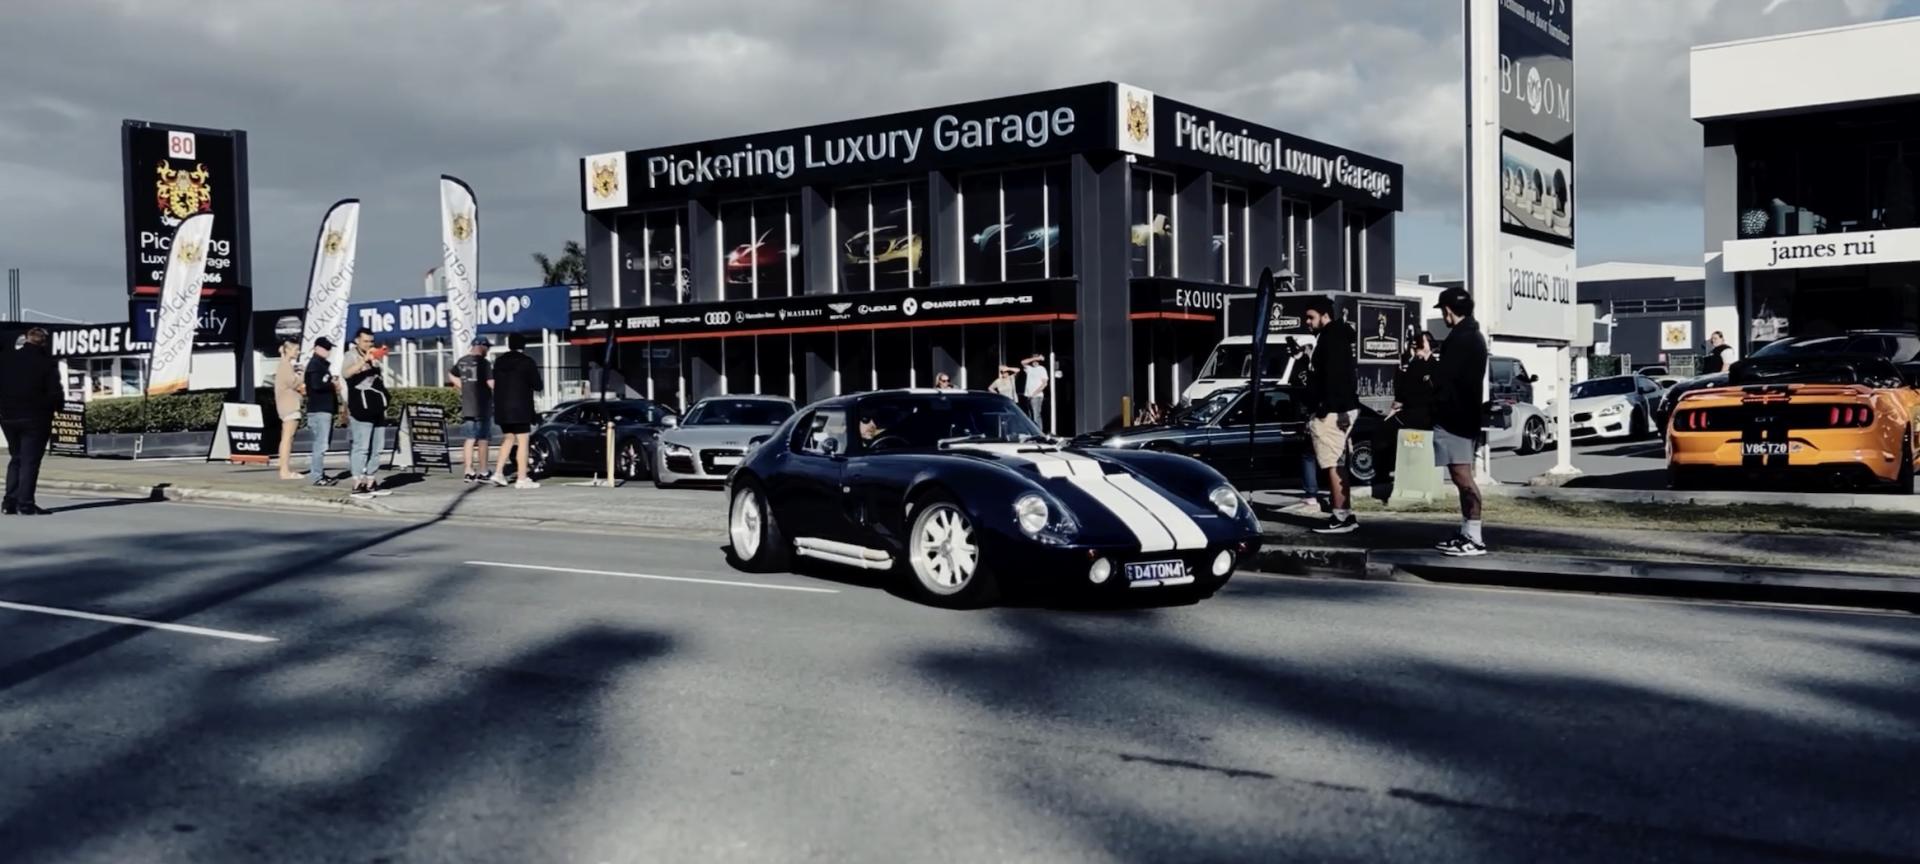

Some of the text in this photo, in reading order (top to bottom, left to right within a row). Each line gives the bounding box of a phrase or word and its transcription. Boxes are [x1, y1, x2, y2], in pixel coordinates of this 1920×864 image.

[171, 136, 193, 155] 80
[648, 106, 1075, 189] Pickering Luxury Garage
[1175, 111, 1391, 199] Pickering Luxury Garage
[1768, 235, 1877, 267] james rui
[1507, 252, 1570, 311] james rui
[359, 308, 396, 332] The
[787, 309, 822, 318] MASERATI
[52, 327, 121, 356] MUSCLE
[230, 431, 262, 440] WE BUY
[236, 442, 261, 451] CARS
